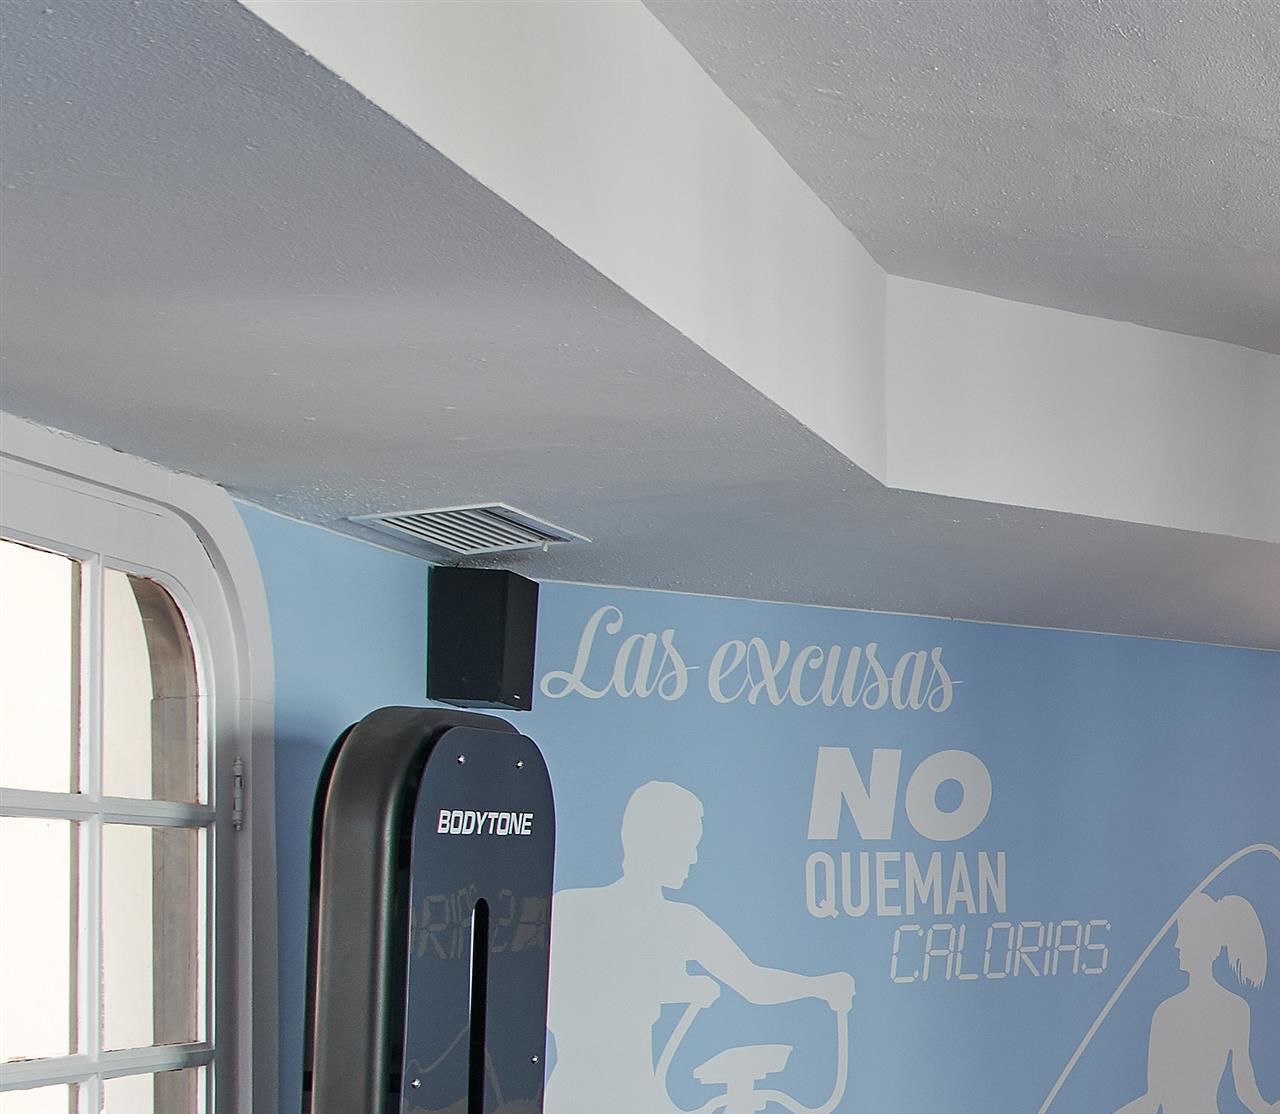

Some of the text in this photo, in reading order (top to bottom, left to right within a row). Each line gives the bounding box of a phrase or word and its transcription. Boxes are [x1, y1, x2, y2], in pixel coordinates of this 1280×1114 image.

[540, 605, 964, 713] Las excusas
[437, 809, 533, 836] BODYTONE
[807, 746, 993, 841] NO
[805, 851, 1007, 919] QUEMAN
[890, 919, 1112, 983] CALORIAS
